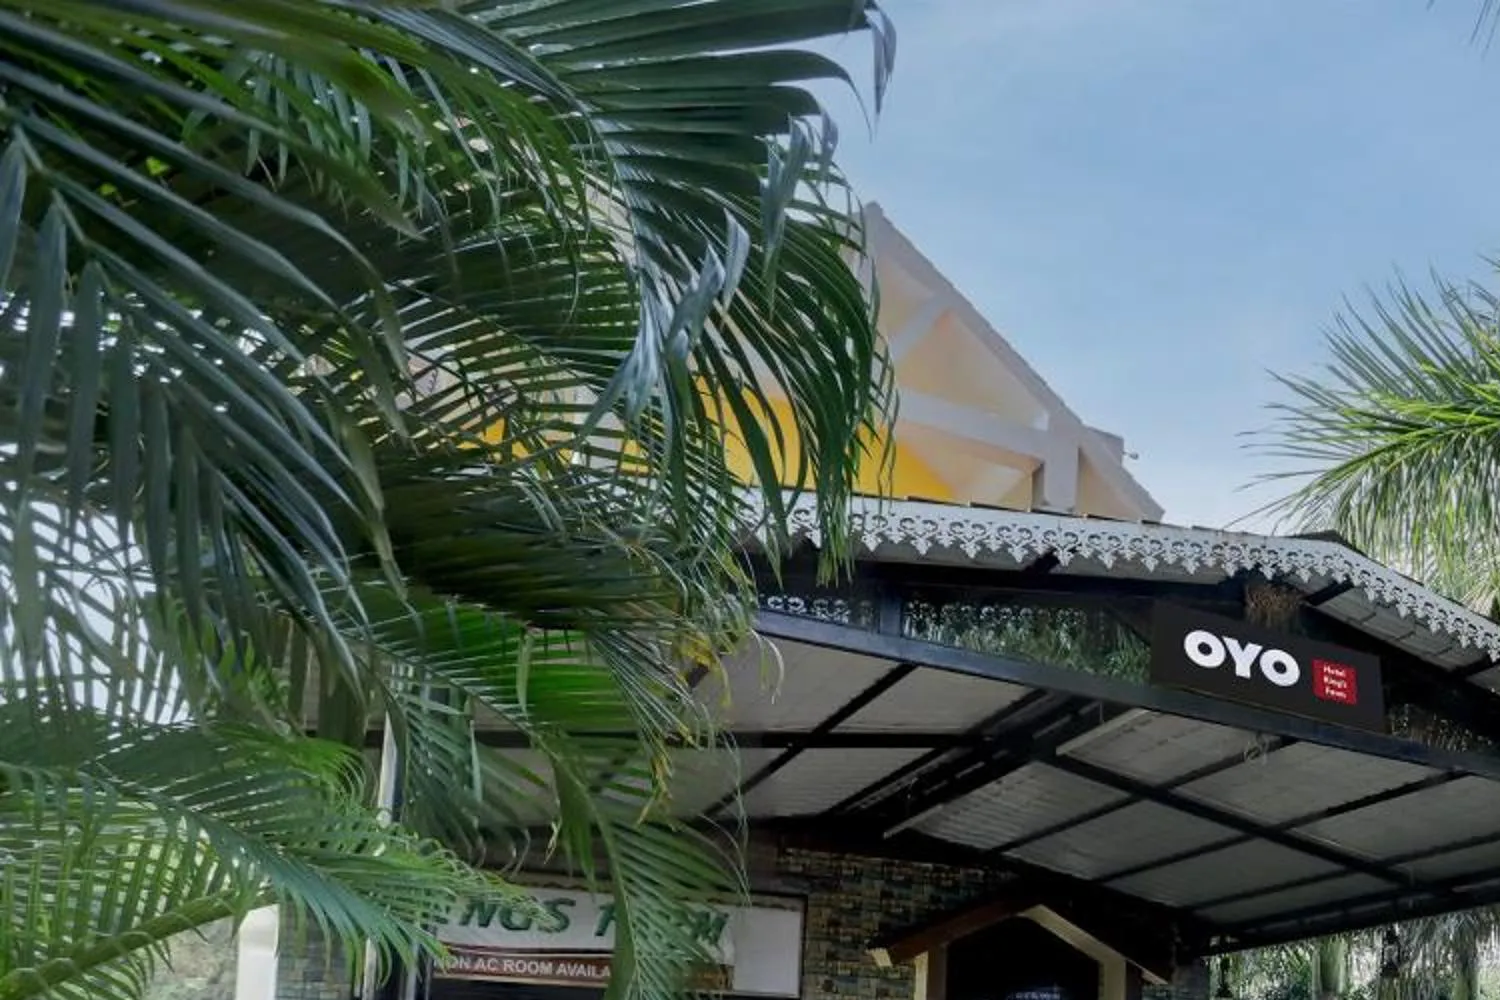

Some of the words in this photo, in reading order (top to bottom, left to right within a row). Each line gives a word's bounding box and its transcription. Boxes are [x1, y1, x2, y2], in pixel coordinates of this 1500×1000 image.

[1184, 630, 1300, 686] OYO
[429, 896, 576, 933] NGS
[473, 958, 499, 971] AC
[503, 959, 553, 974] ROOM
[558, 963, 612, 977] AVAILA
